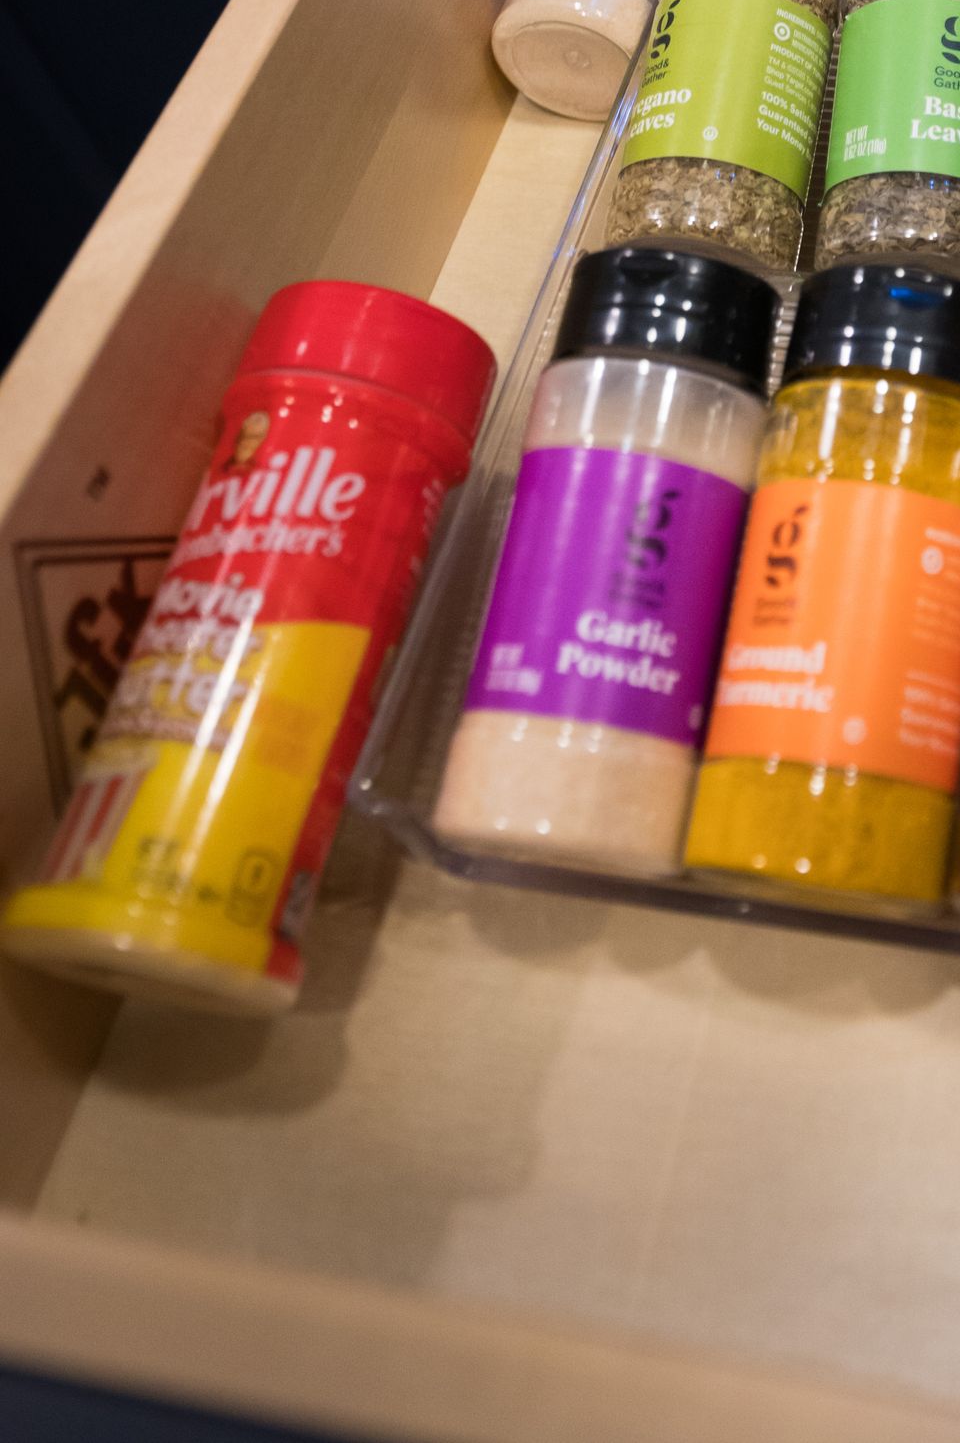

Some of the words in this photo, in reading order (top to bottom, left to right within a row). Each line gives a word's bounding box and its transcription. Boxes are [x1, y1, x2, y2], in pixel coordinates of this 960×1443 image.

[762, 91, 788, 109] 100%
[756, 117, 779, 135] Your
[758, 104, 808, 139] Guaranteed
[190, 446, 366, 531] rville
[576, 609, 678, 658] Garlic
[556, 641, 681, 696] Powder
